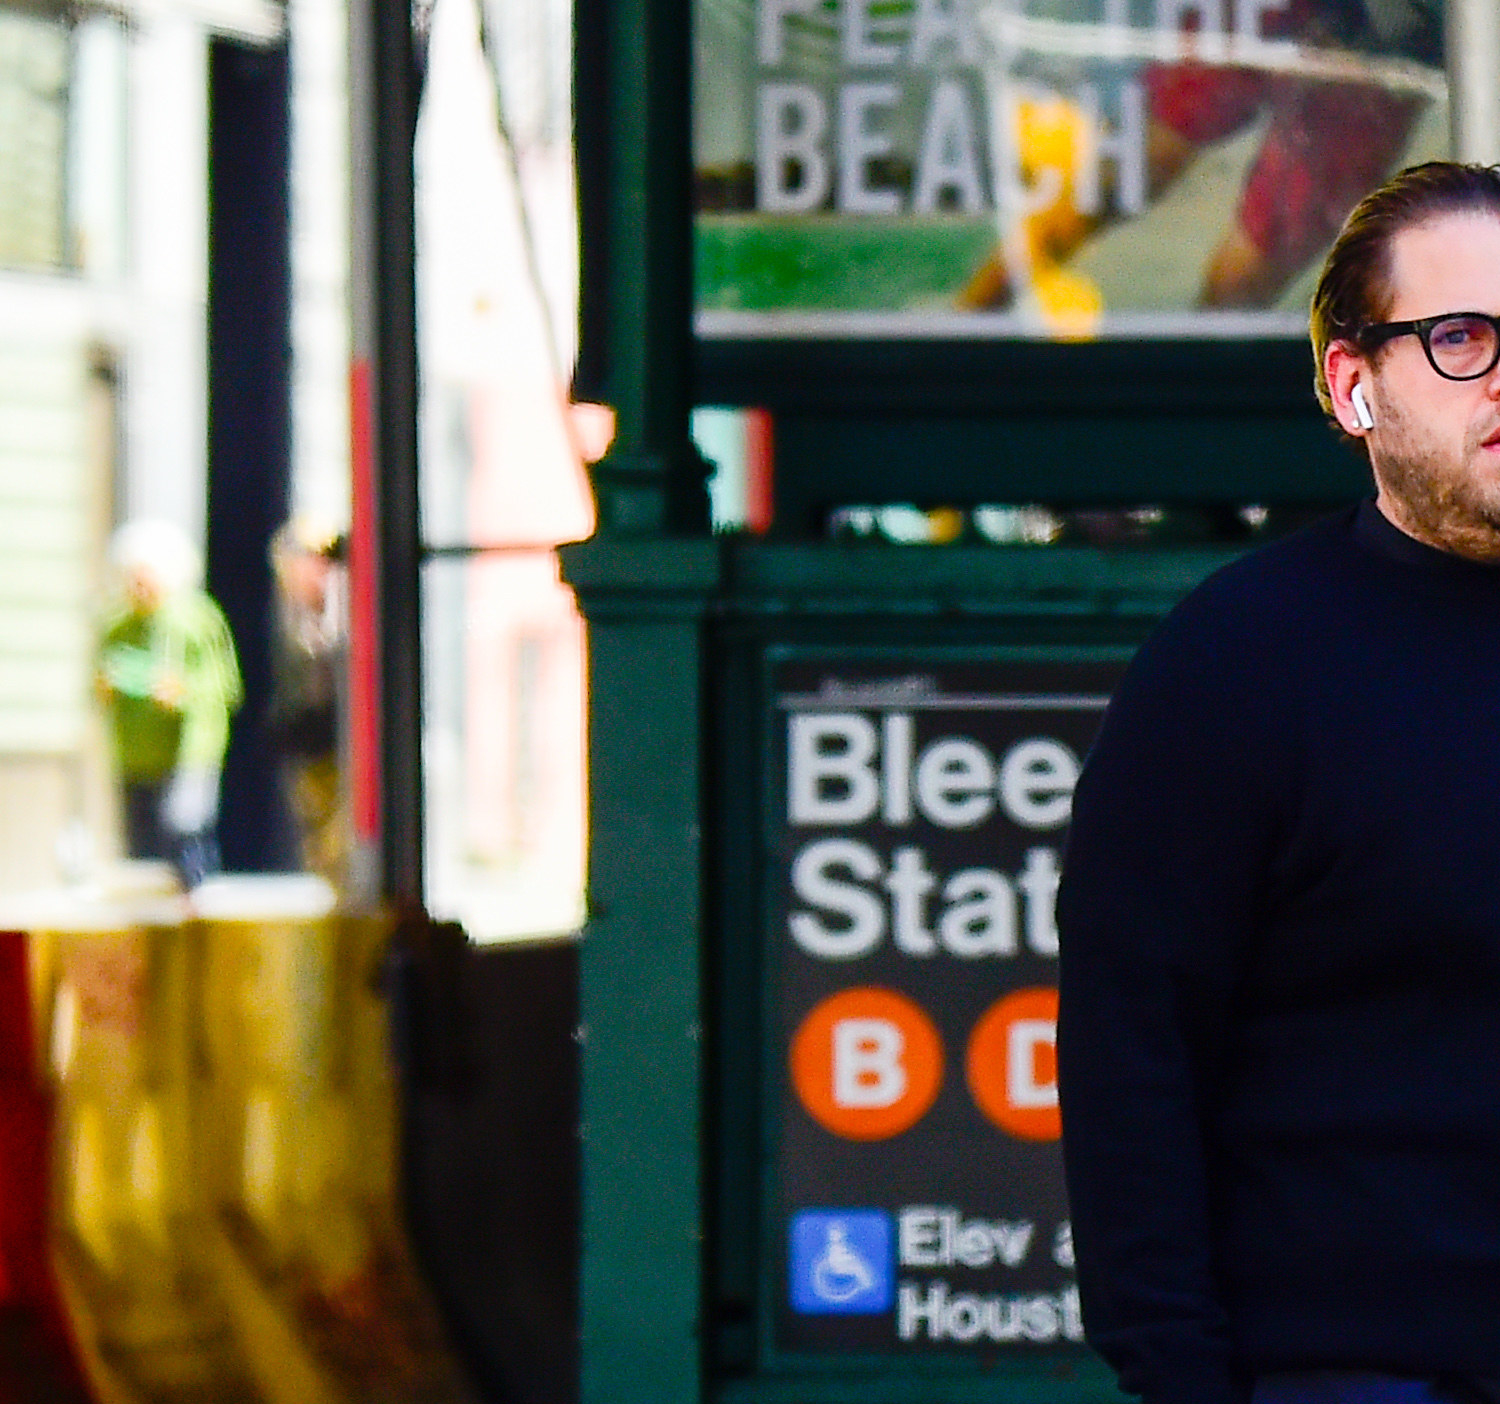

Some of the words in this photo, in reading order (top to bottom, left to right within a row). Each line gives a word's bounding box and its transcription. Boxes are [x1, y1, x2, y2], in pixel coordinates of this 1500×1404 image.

[757, 81, 1146, 214] BEACH
[832, 1018, 908, 1110] B
[898, 1204, 1035, 1268] Elev
